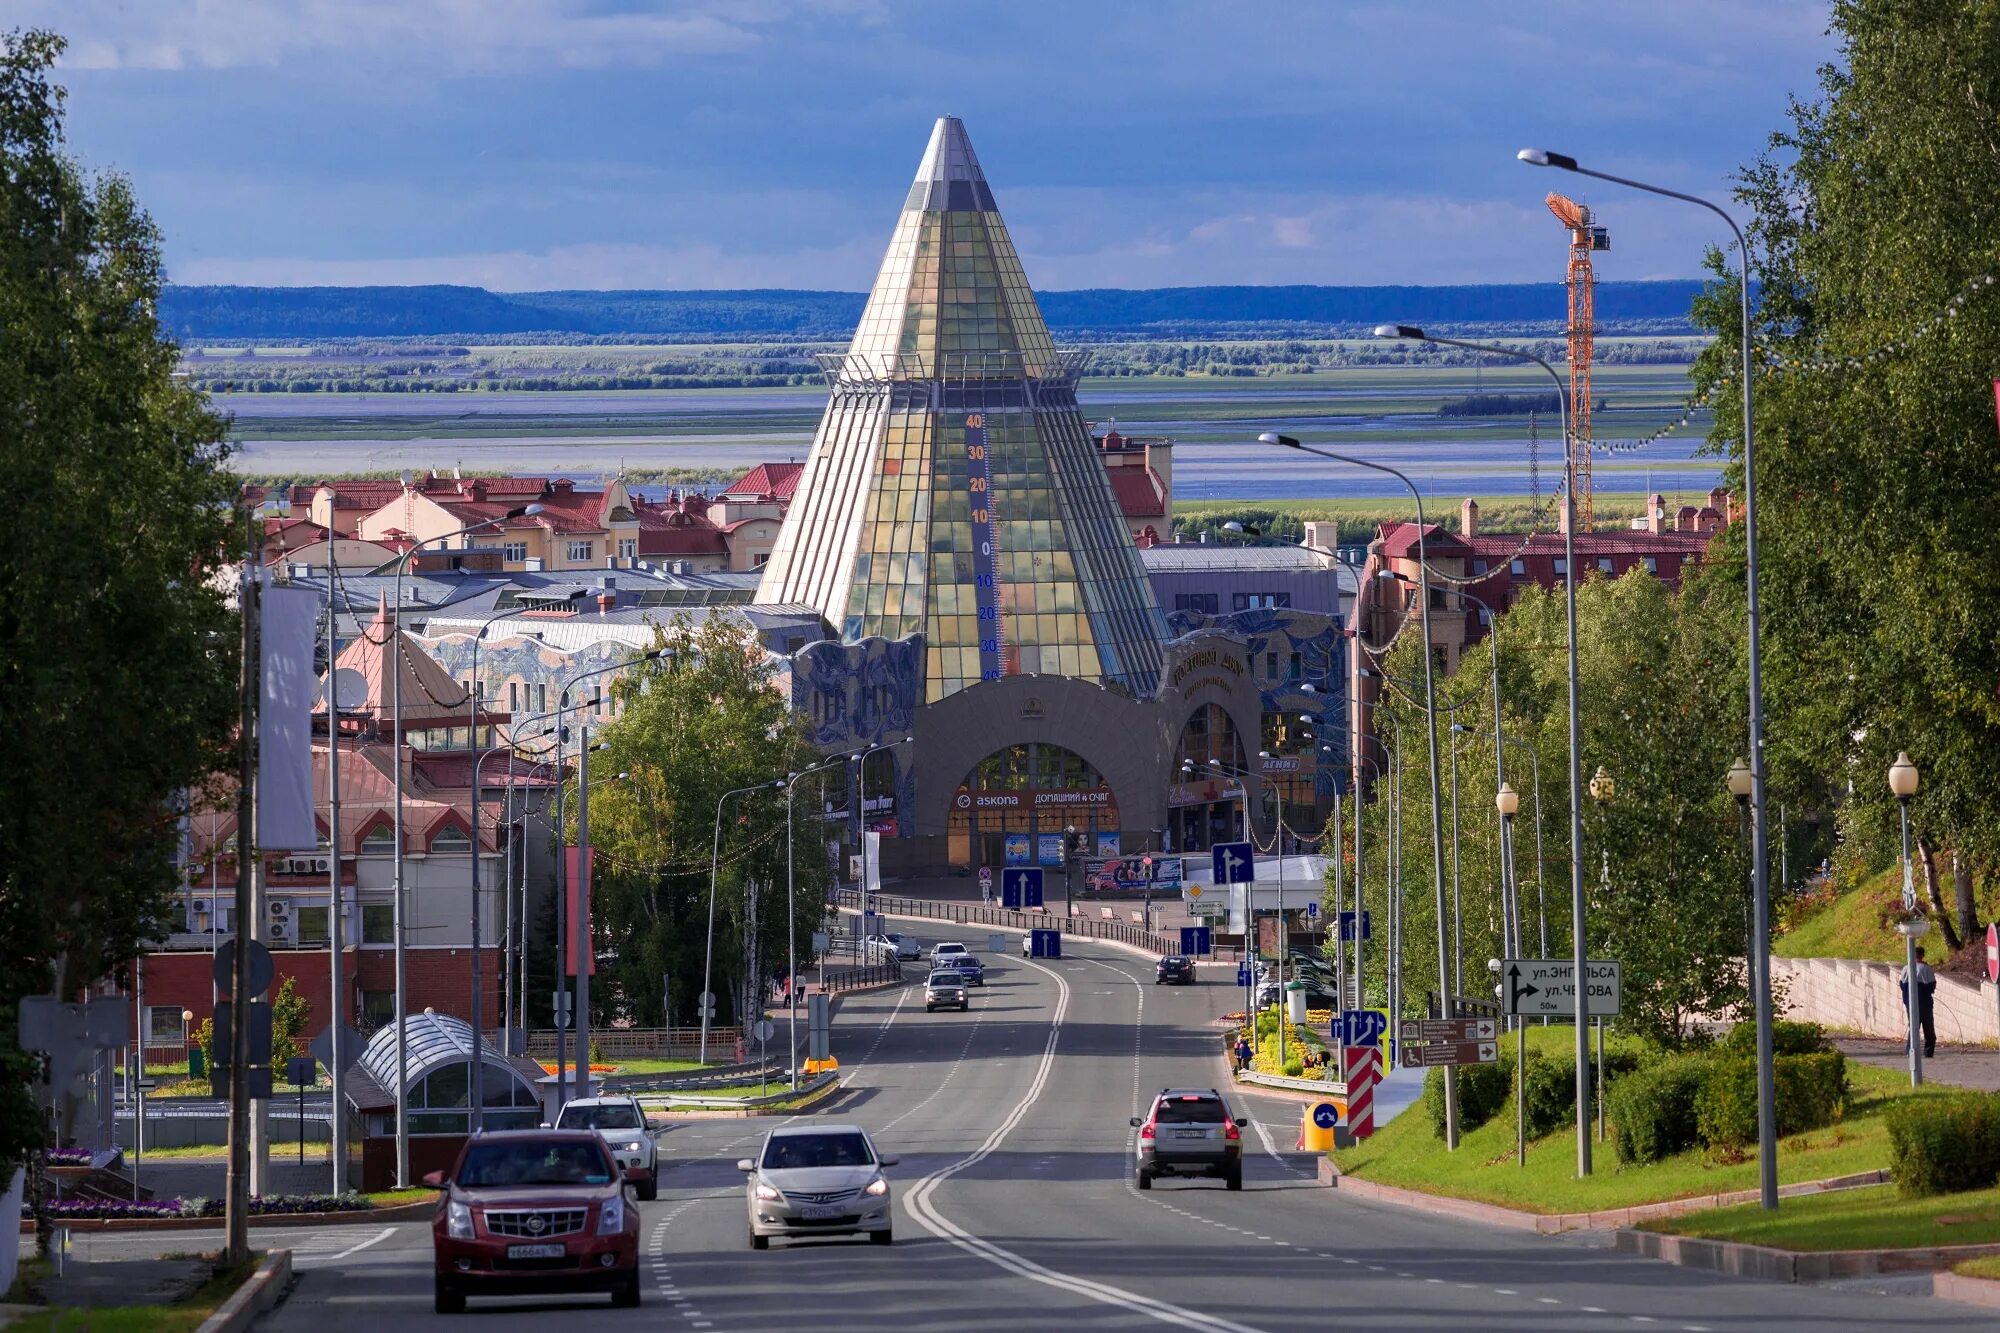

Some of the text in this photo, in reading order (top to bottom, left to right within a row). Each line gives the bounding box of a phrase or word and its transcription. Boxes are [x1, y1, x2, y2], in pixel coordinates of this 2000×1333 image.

[966, 414, 983, 429] 40
[967, 446, 985, 460] 30
[969, 477, 987, 492] 20
[971, 509, 989, 523] 10
[981, 541, 991, 556] 0
[977, 575, 992, 587] 10
[979, 606, 995, 620] 20
[981, 639, 997, 652] 30
[976, 796, 1019, 806] askona
[1034, 792, 1110, 804] ДОМАШНИЙ ОЧАГ
[1533, 966, 1616, 980] ул.ЭНГЛЬСА
[1545, 985, 1613, 998] ул.ЧЕОВА
[1540, 1002, 1558, 1010] 50м
